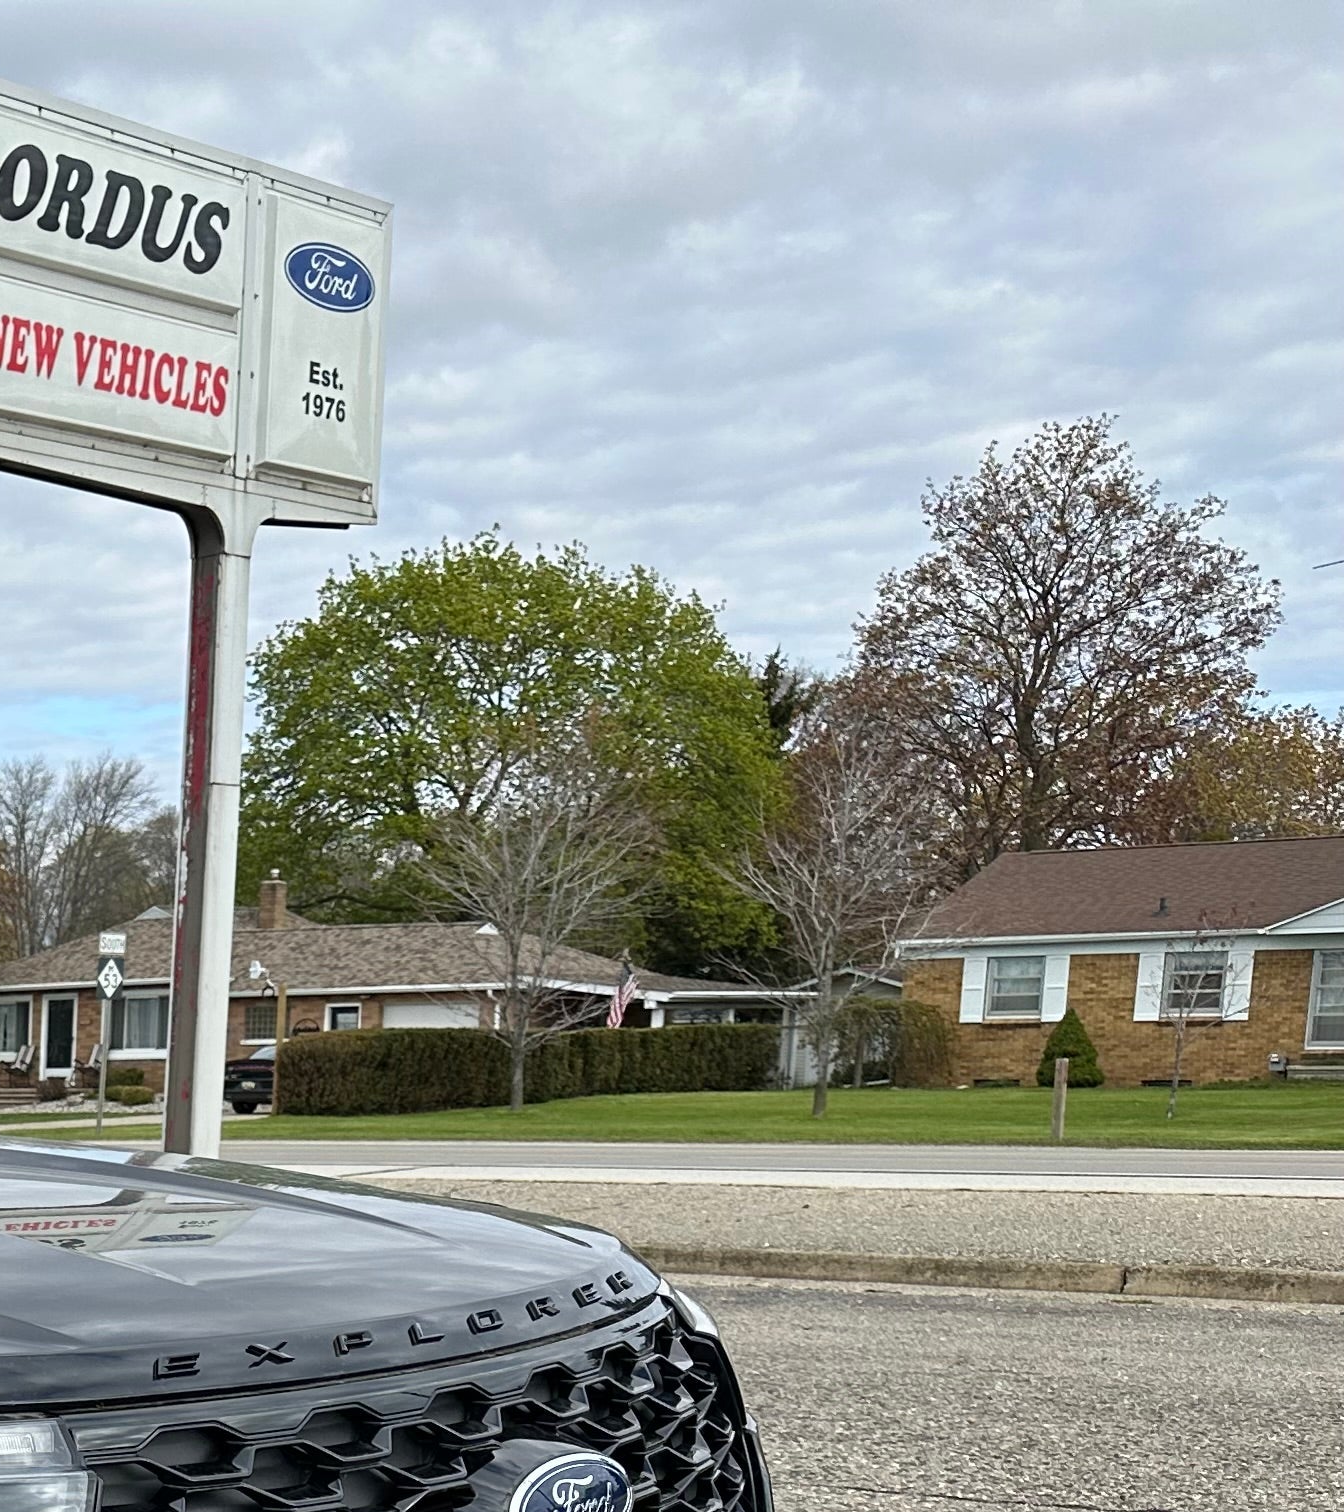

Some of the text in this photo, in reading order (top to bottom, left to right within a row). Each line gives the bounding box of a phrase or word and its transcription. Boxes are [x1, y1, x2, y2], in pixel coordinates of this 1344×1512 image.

[305, 252, 357, 301] Ford
[73, 331, 230, 418] VEHICLES
[309, 360, 344, 391] Est.
[301, 391, 346, 423] 1976
[103, 973, 118, 989] 53
[152, 1270, 634, 1381] EXPLORER
